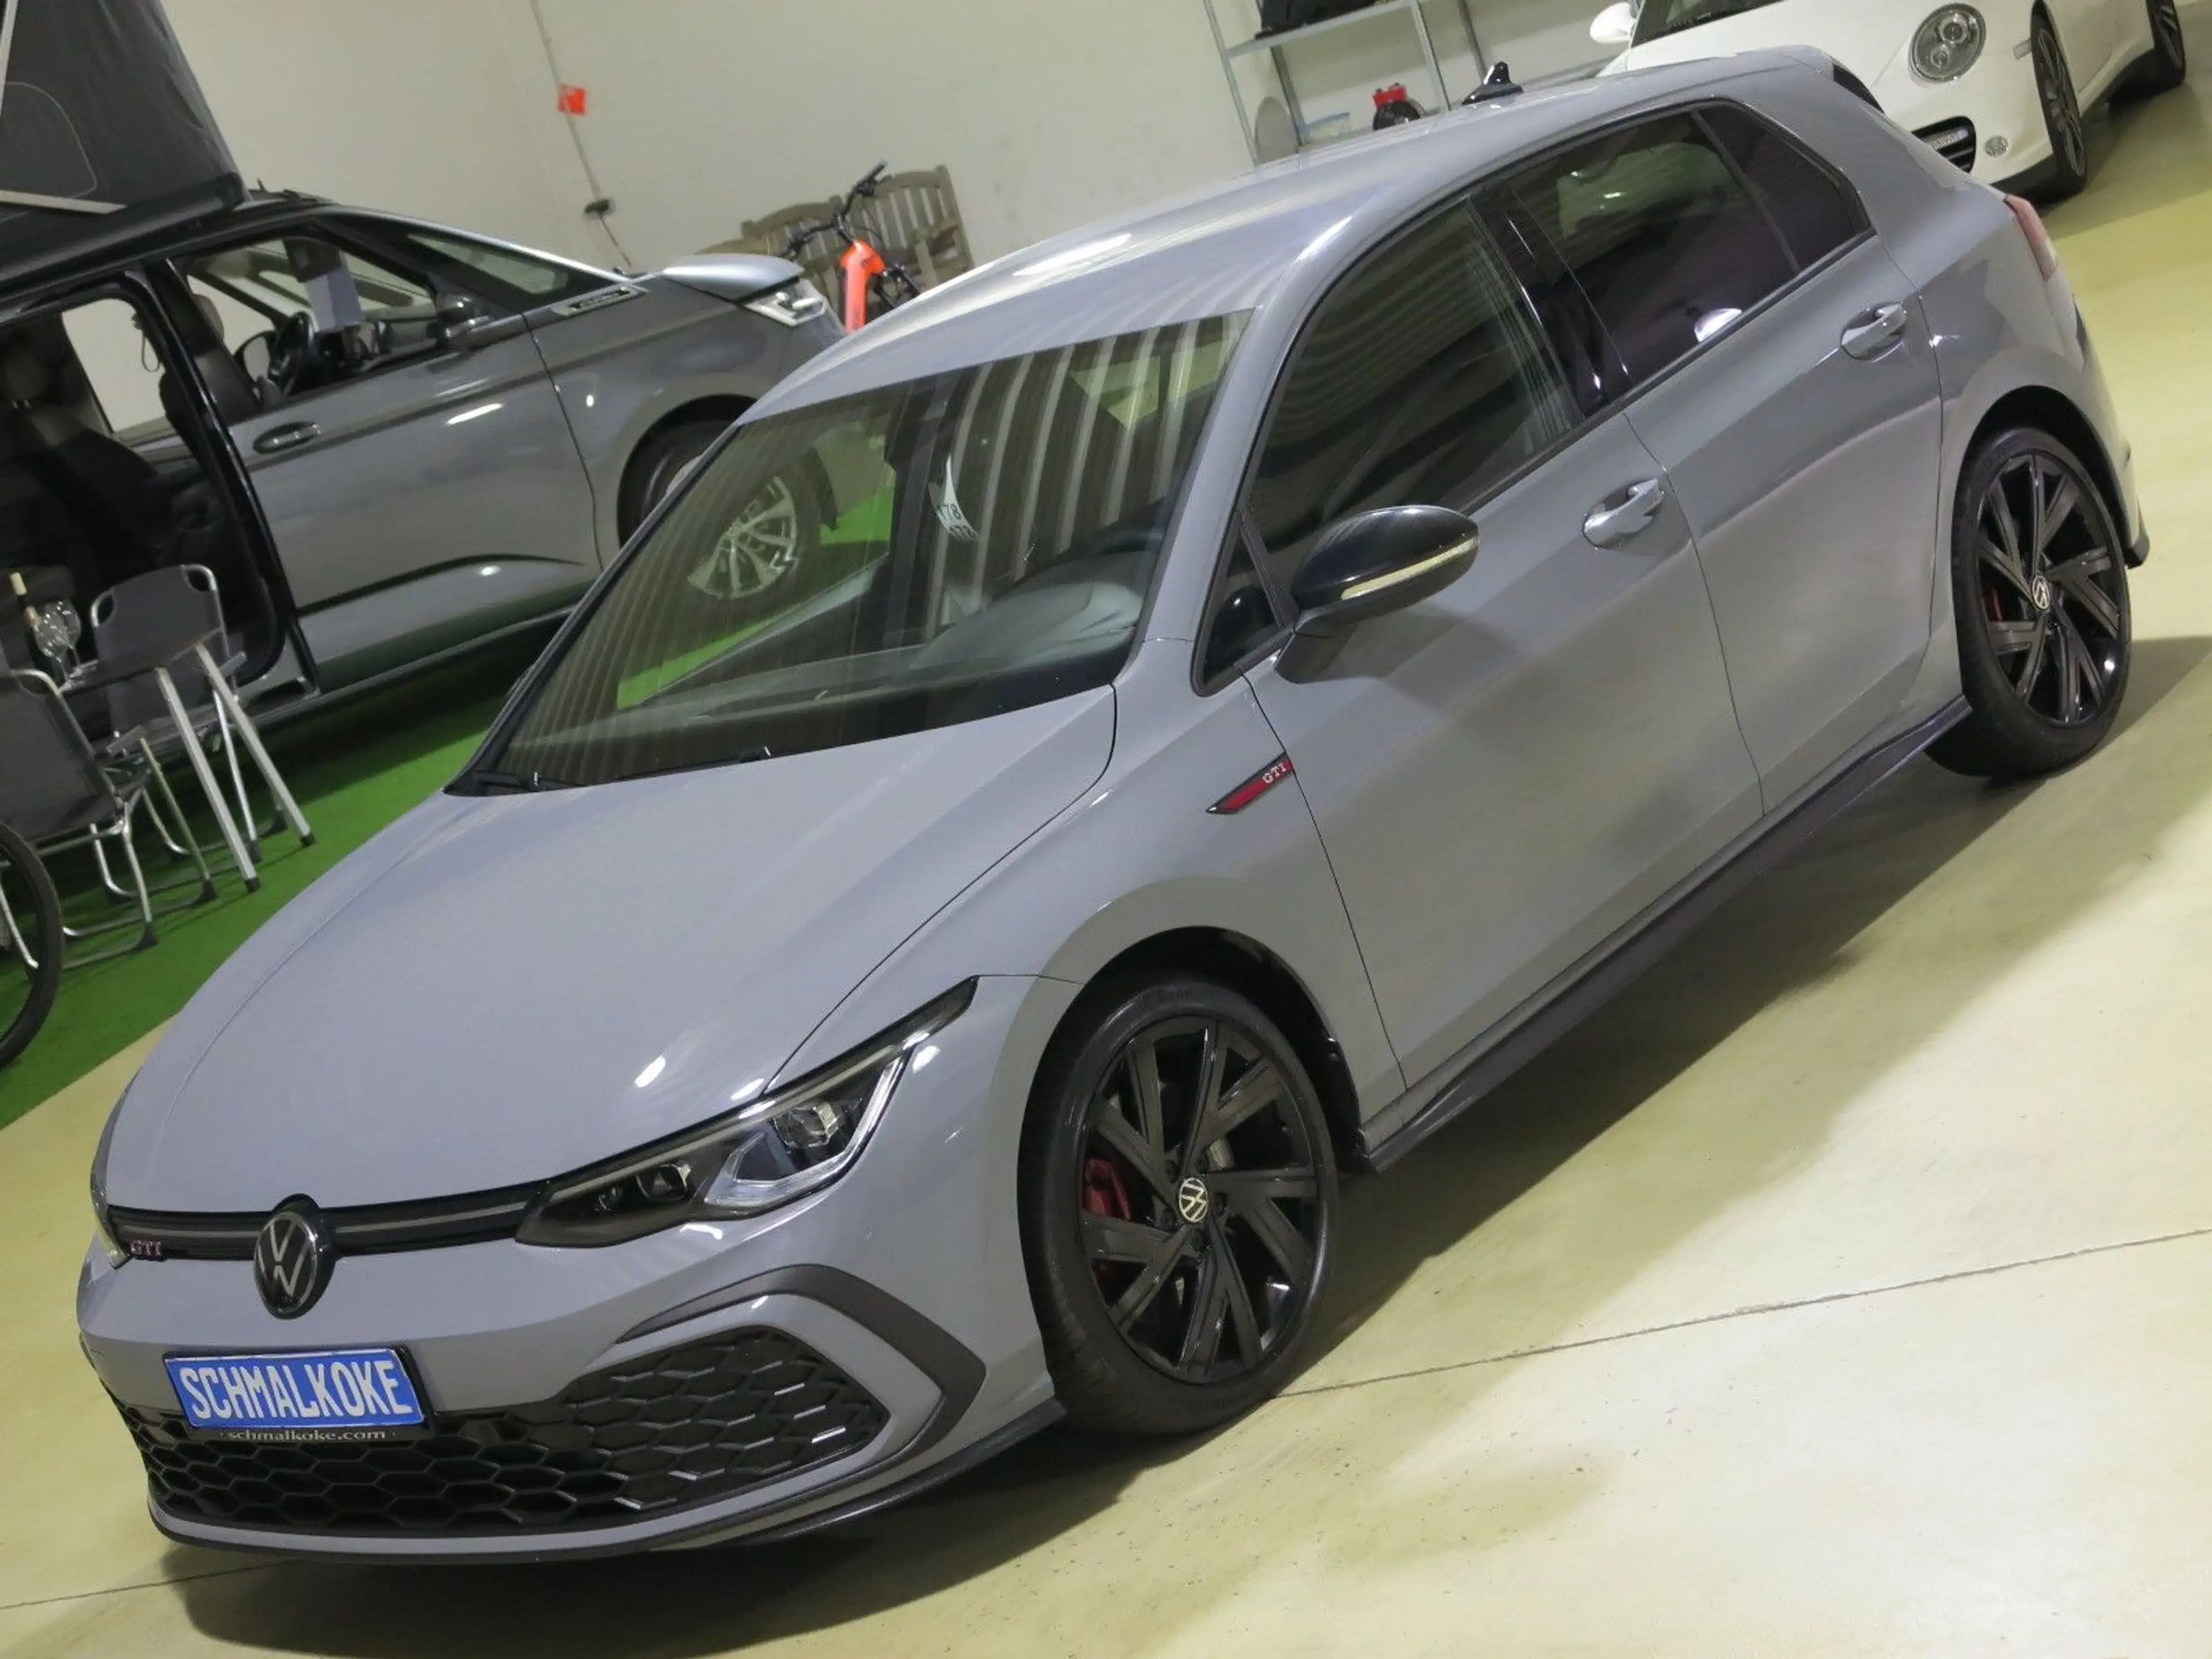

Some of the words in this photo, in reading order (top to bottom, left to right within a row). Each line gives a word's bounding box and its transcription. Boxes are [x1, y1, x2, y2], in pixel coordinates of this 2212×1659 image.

[1262, 763, 1286, 783] GTI
[131, 1240, 162, 1255] GTI
[180, 1360, 412, 1419] SCHMALKOKE
[229, 1429, 386, 1441] schmalkoke.com
